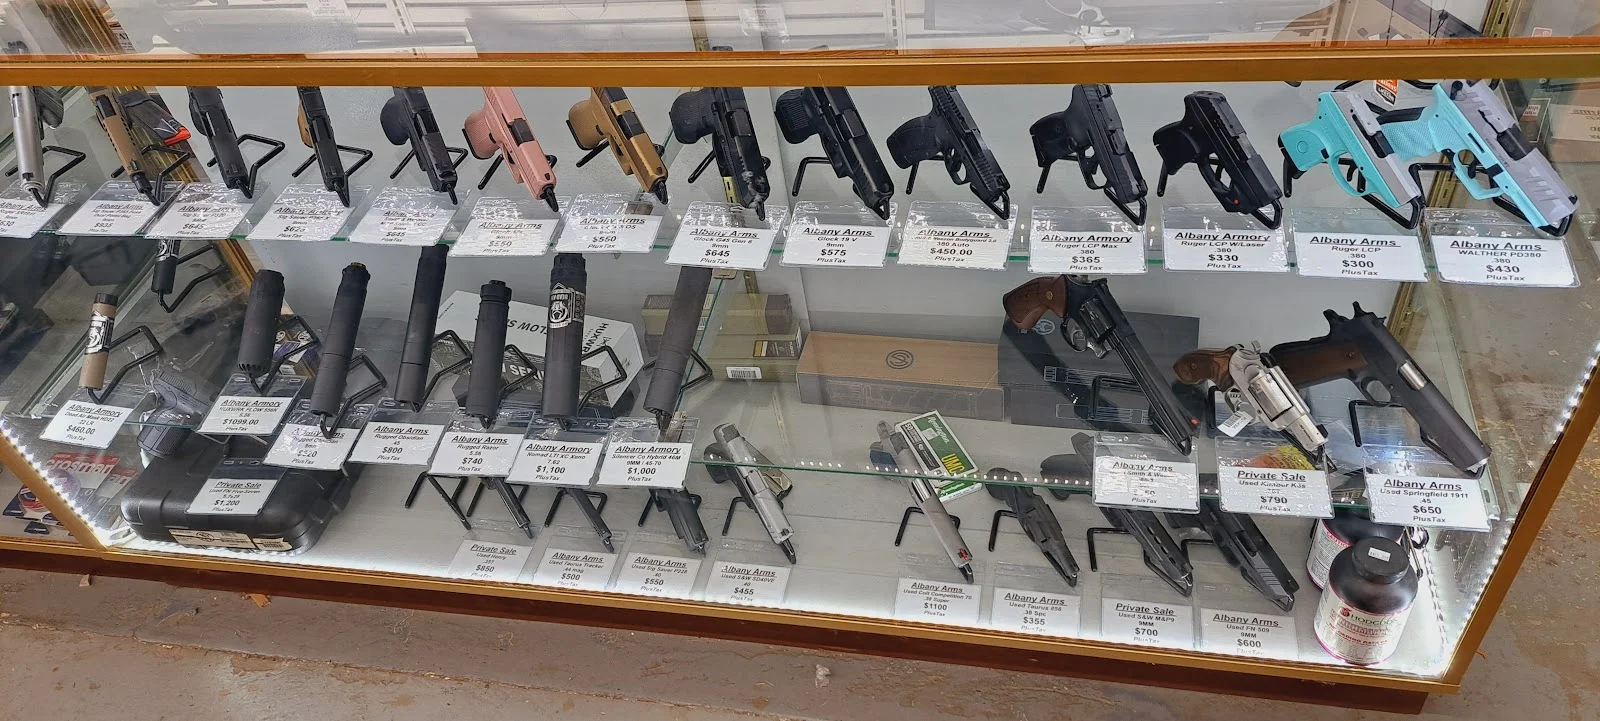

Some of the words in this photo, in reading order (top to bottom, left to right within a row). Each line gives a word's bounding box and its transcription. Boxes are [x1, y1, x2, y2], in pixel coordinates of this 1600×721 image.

[1088, 236, 1132, 244] Armory
[1175, 232, 1218, 242] Albany
[1222, 233, 1270, 242] Armory
[1310, 236, 1356, 246] Albany
[1360, 238, 1396, 246] Arms
[1451, 240, 1496, 250] Albany
[1499, 242, 1541, 250] Arms
[1071, 256, 1100, 264] $365
[1208, 254, 1239, 262] $330
[1342, 260, 1374, 268] $300
[1486, 265, 1520, 273] $430
[68, 404, 94, 413] Albany
[96, 408, 123, 417] Armory
[67, 425, 95, 434] $460.00
[374, 426, 404, 434] Albany
[452, 436, 482, 444] Albany
[526, 444, 557, 453] Albany
[560, 445, 592, 453] Armory
[650, 446, 681, 454] Armory
[45, 460, 115, 474] crosman
[941, 453, 965, 473] UMC
[536, 466, 565, 474] $1,100
[627, 467, 656, 475] $1,000
[1238, 471, 1276, 480] Private
[1384, 479, 1425, 490] Albany
[1430, 482, 1462, 490] Arms
[1403, 490, 1448, 498] Springfield
[1261, 496, 1287, 504] $790
[1413, 506, 1442, 514] $650
[471, 544, 498, 554] Private
[553, 552, 580, 561] Albany
[582, 554, 604, 562] Arms
[634, 556, 663, 566] Albany
[665, 559, 687, 567] Arms
[753, 568, 776, 577] Arms
[734, 587, 754, 595] $455
[911, 582, 939, 592] Albany
[941, 585, 963, 593] Arms
[1005, 593, 1036, 603] Albany
[1039, 596, 1065, 605] Arms
[1116, 603, 1151, 614] Private
[1153, 607, 1174, 615] Sale
[1023, 617, 1045, 625] $355
[1213, 614, 1248, 624] Albany
[1252, 618, 1279, 626] Arms
[1135, 627, 1158, 636] $700
[1237, 639, 1261, 647] $600
